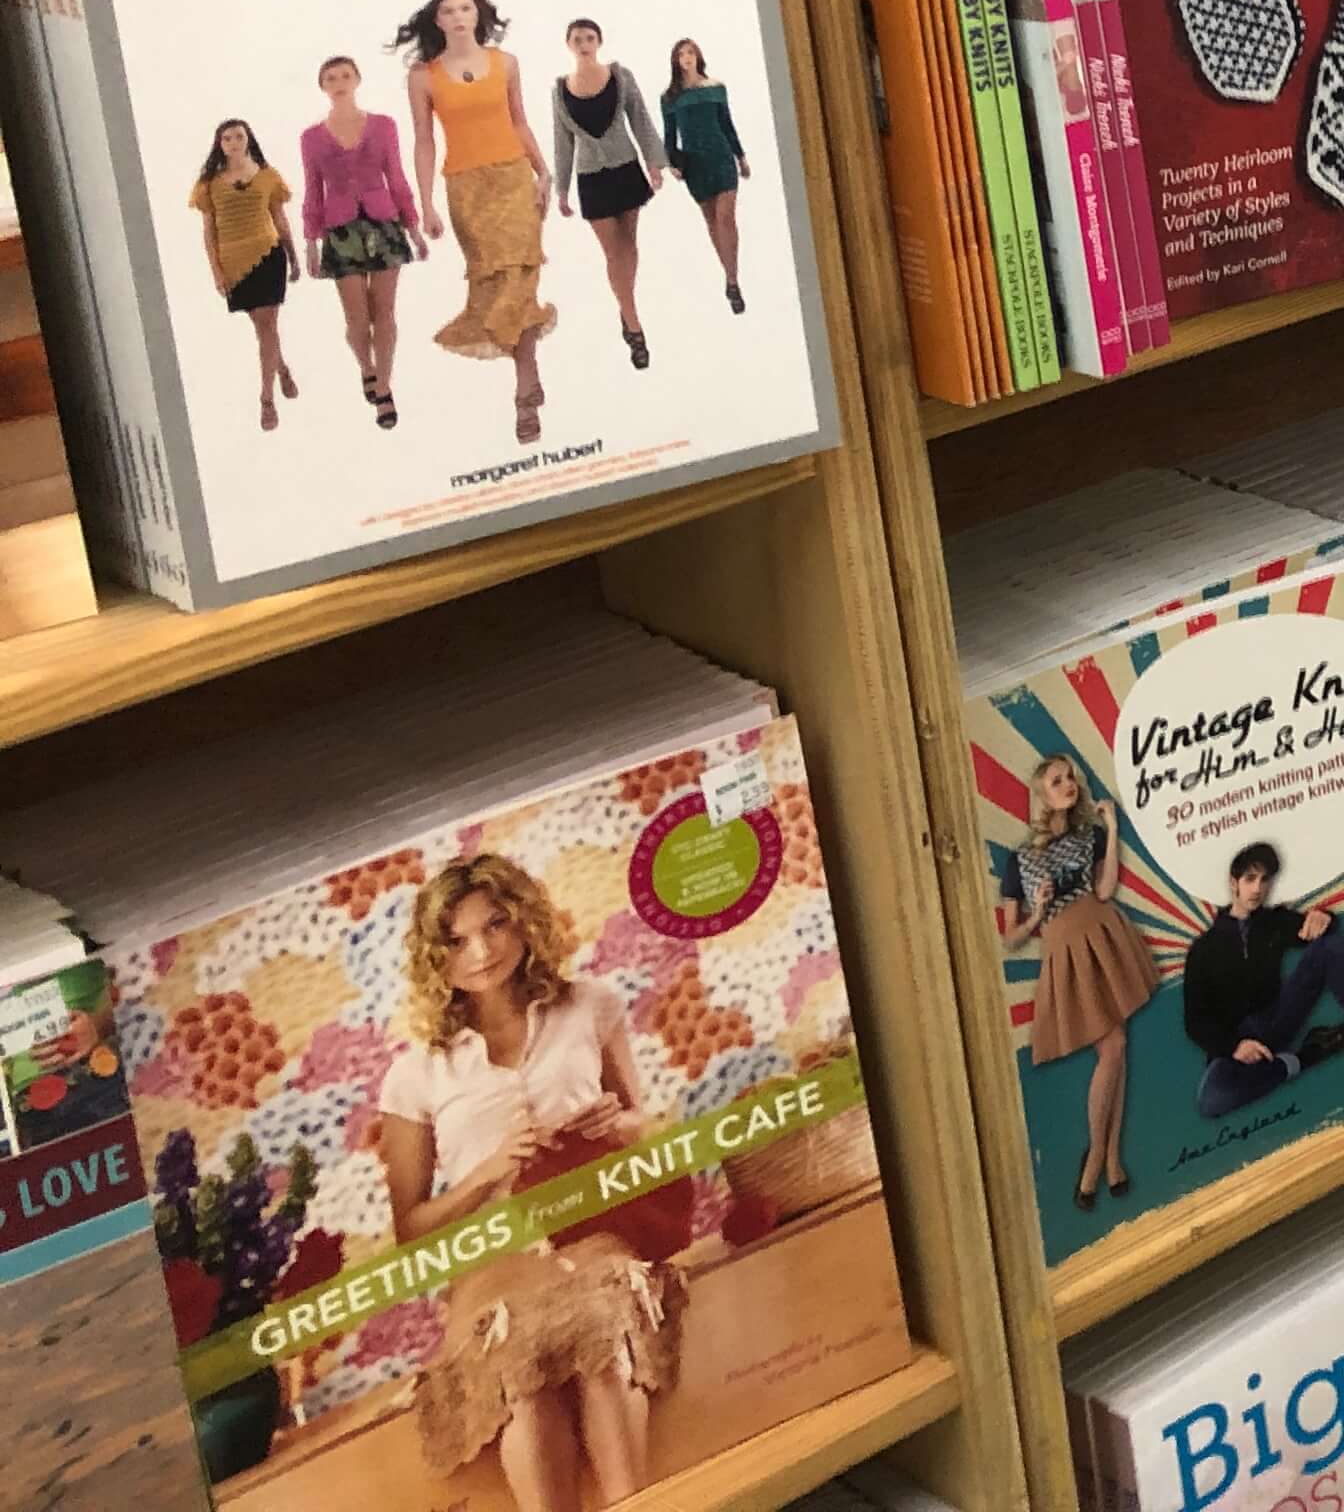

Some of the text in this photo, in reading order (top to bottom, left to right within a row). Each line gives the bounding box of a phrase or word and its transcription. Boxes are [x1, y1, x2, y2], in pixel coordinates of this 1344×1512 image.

[969, 28, 992, 92] KNITS
[1159, 144, 1294, 189] Twenty Heirloom
[1160, 177, 1258, 210] Projects in a
[1162, 190, 1291, 233] Variety of Styles
[1164, 213, 1284, 256] and Techniques
[1166, 250, 1287, 292] Edited by Kari Cornell
[450, 437, 604, 490] margaret hubert
[1130, 696, 1274, 768] Vintage
[1175, 829, 1197, 850] for
[1200, 808, 1249, 841] stylish
[1251, 789, 1304, 823] vintage
[19, 1144, 132, 1220] LOVE
[249, 1081, 826, 1359] GREETINGS from KNIT CAFE
